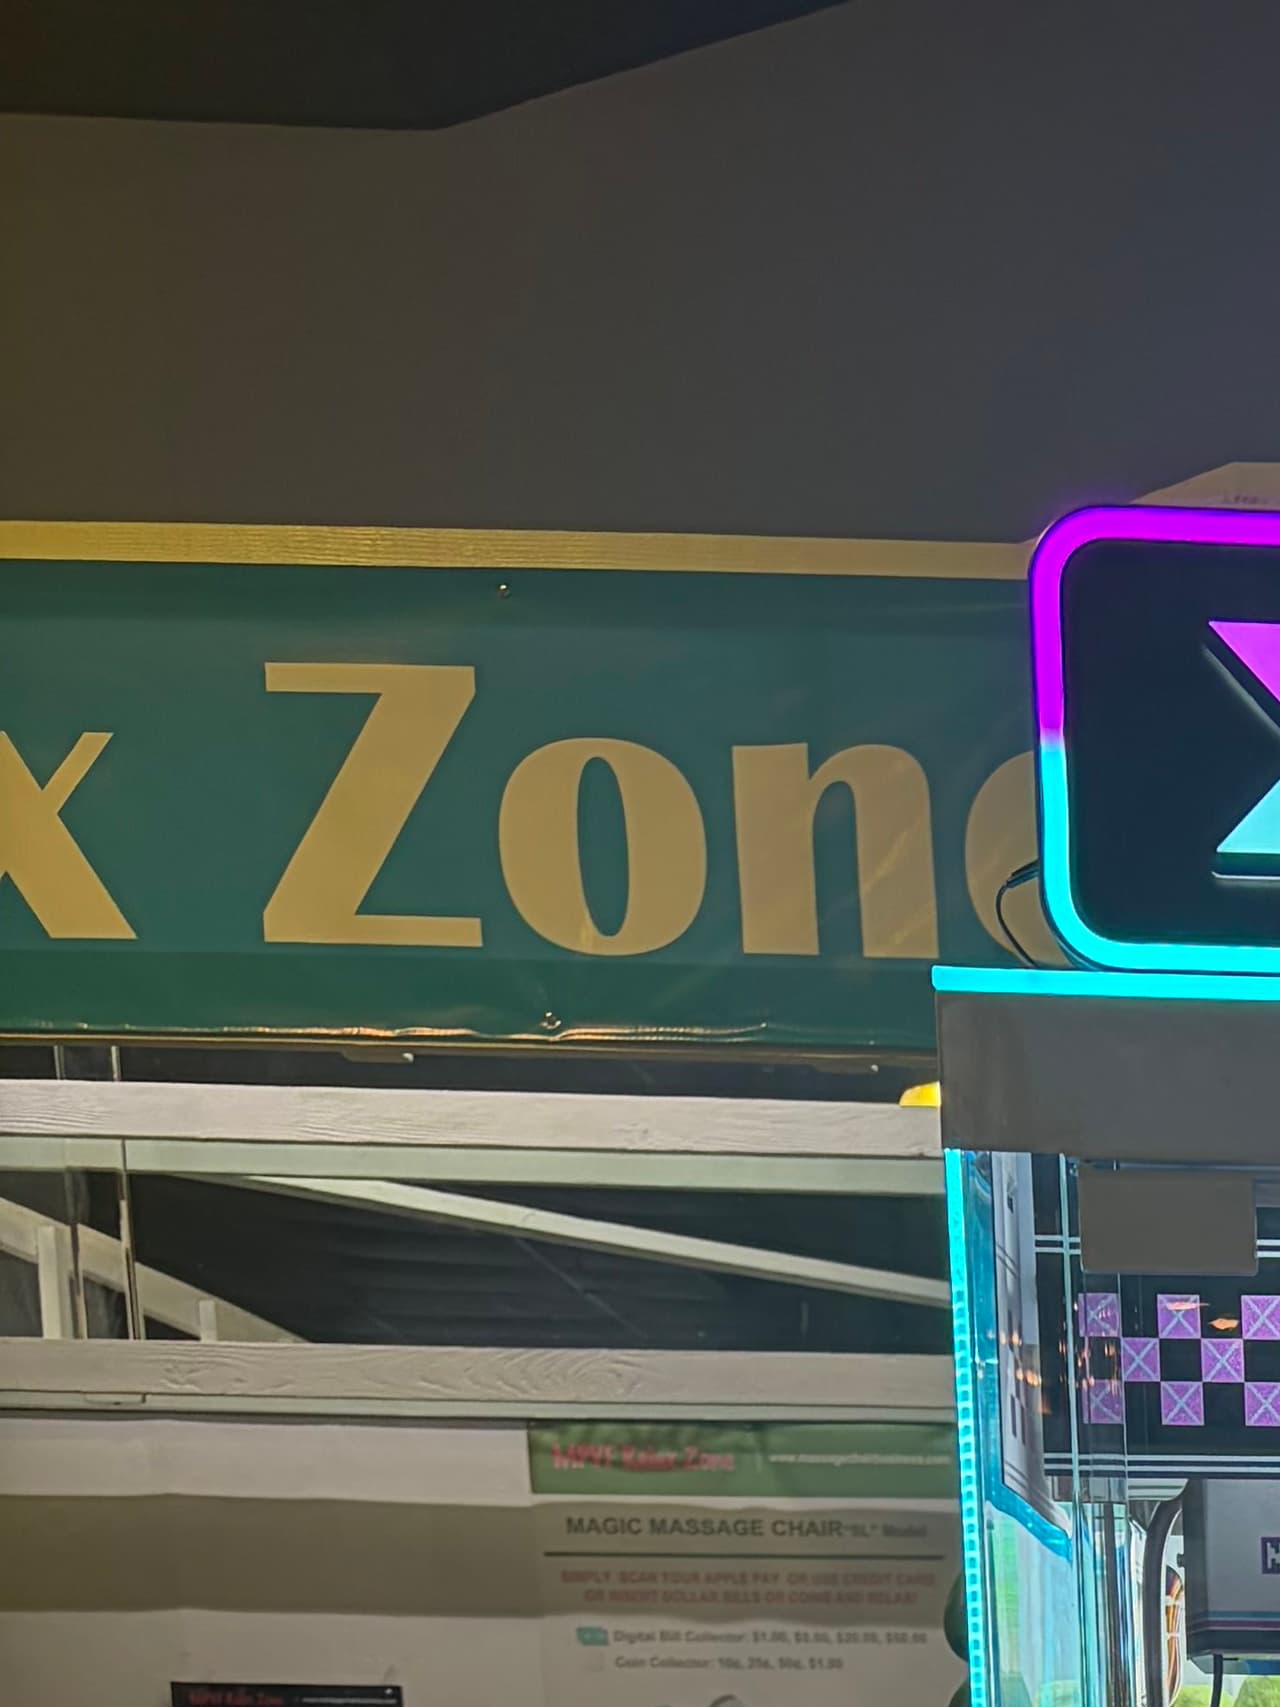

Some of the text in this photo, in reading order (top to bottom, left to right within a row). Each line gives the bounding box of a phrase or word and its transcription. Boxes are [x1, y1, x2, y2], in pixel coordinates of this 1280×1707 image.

[566, 1517, 642, 1535] MAGIC
[649, 1517, 764, 1537] MASSAGE
[771, 1519, 843, 1538] CHAIR
